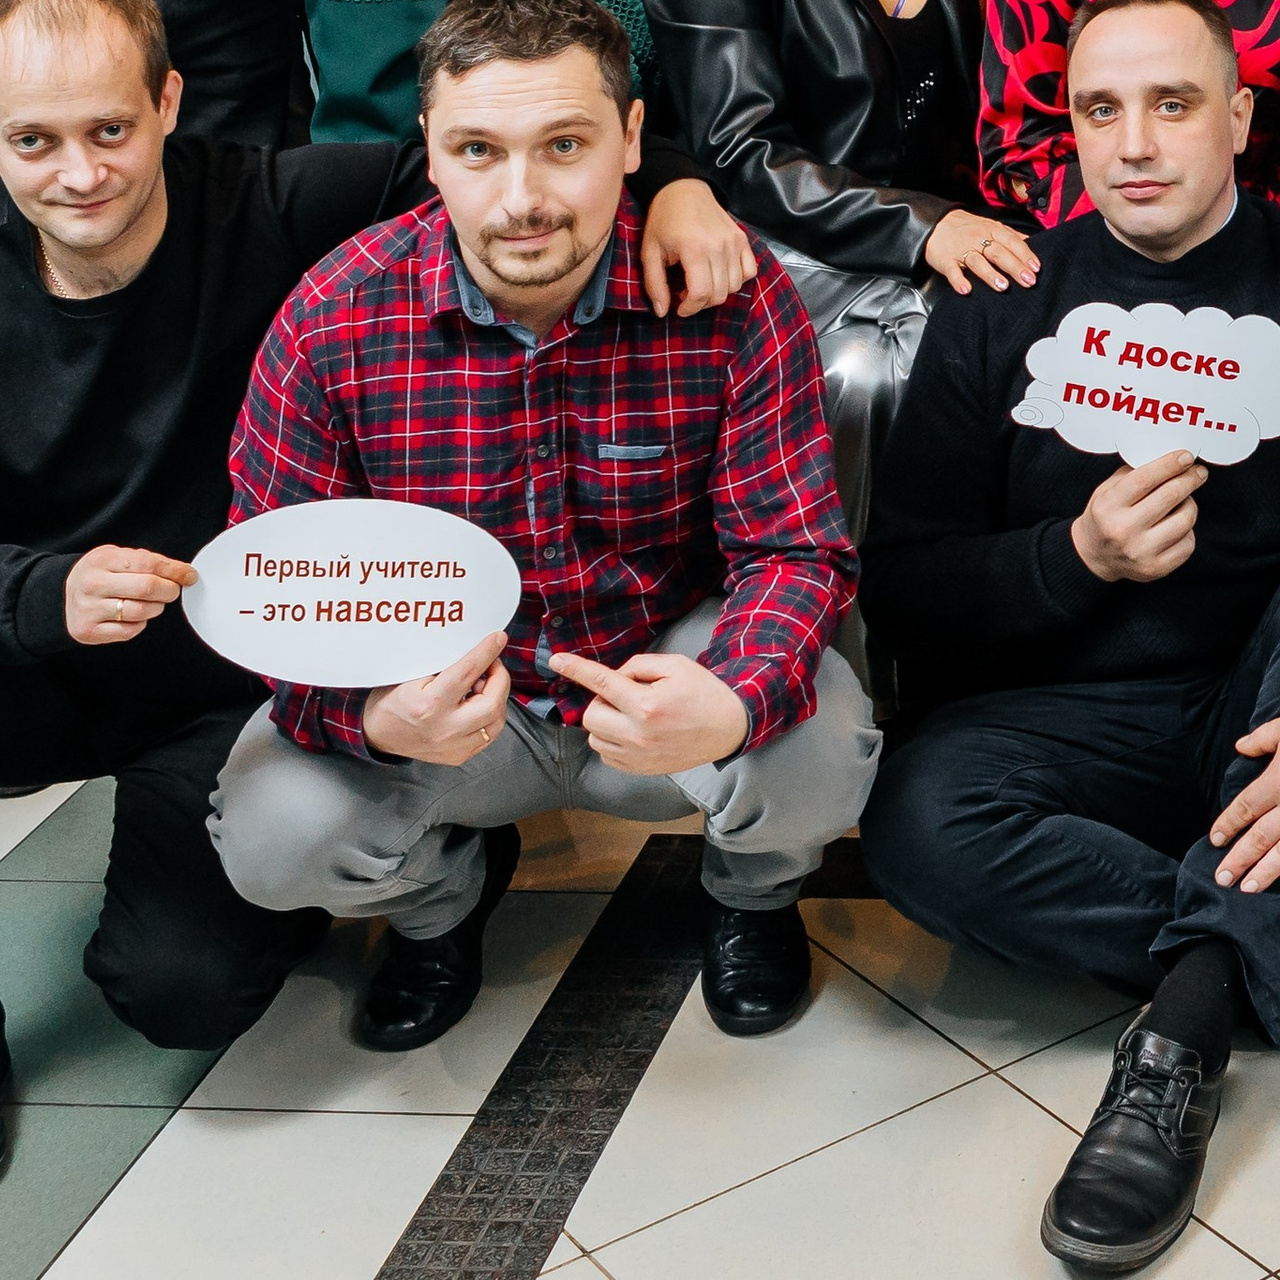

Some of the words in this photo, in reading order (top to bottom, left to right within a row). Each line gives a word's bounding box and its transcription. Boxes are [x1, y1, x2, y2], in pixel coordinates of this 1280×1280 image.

[1082, 326, 1111, 357] К
[1118, 341, 1241, 380] доске
[1062, 382, 1238, 433] пойдет...
[244, 553, 351, 583] Первый
[359, 559, 467, 585] учитель
[262, 603, 306, 622] это
[316, 599, 464, 627] навсегда
